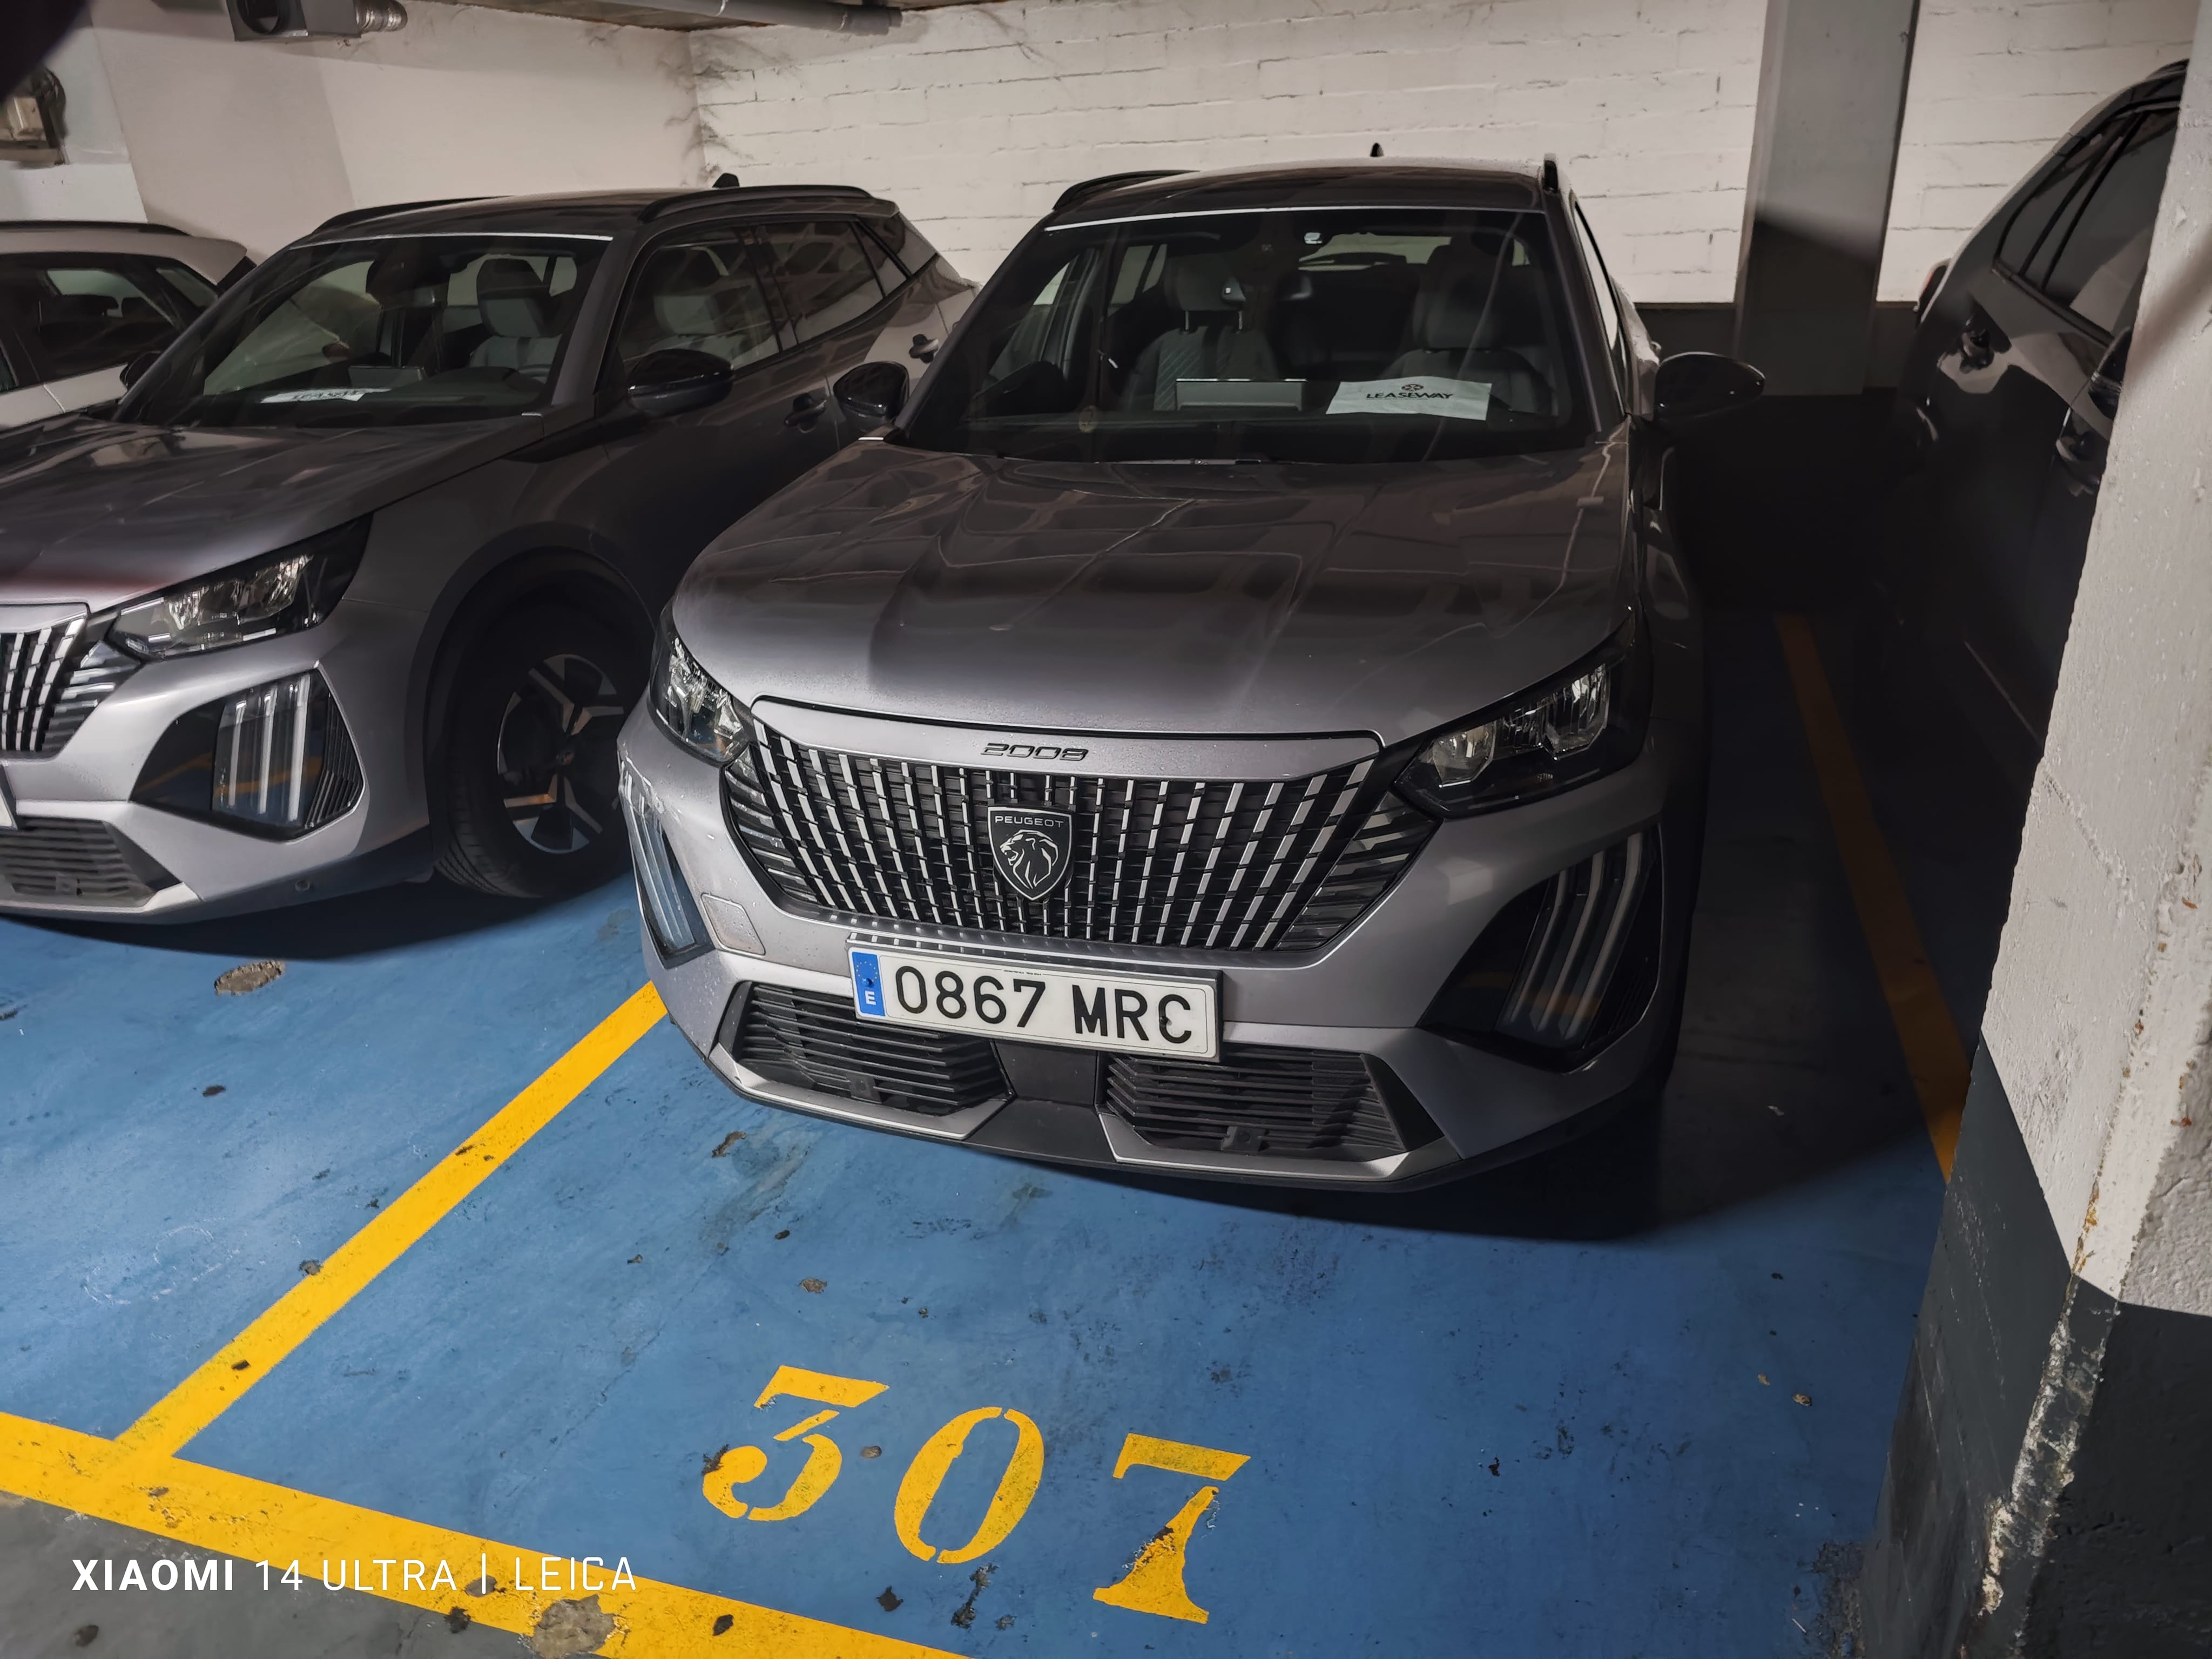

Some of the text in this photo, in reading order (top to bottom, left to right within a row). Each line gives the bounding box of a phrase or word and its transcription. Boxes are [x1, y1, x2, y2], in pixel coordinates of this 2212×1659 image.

[980, 743, 1089, 761] 2008
[994, 815, 1064, 828] PEUGEOT
[865, 990, 876, 1006] E
[894, 965, 1192, 1044] 0867 MRC
[702, 1365, 1252, 1624] 307
